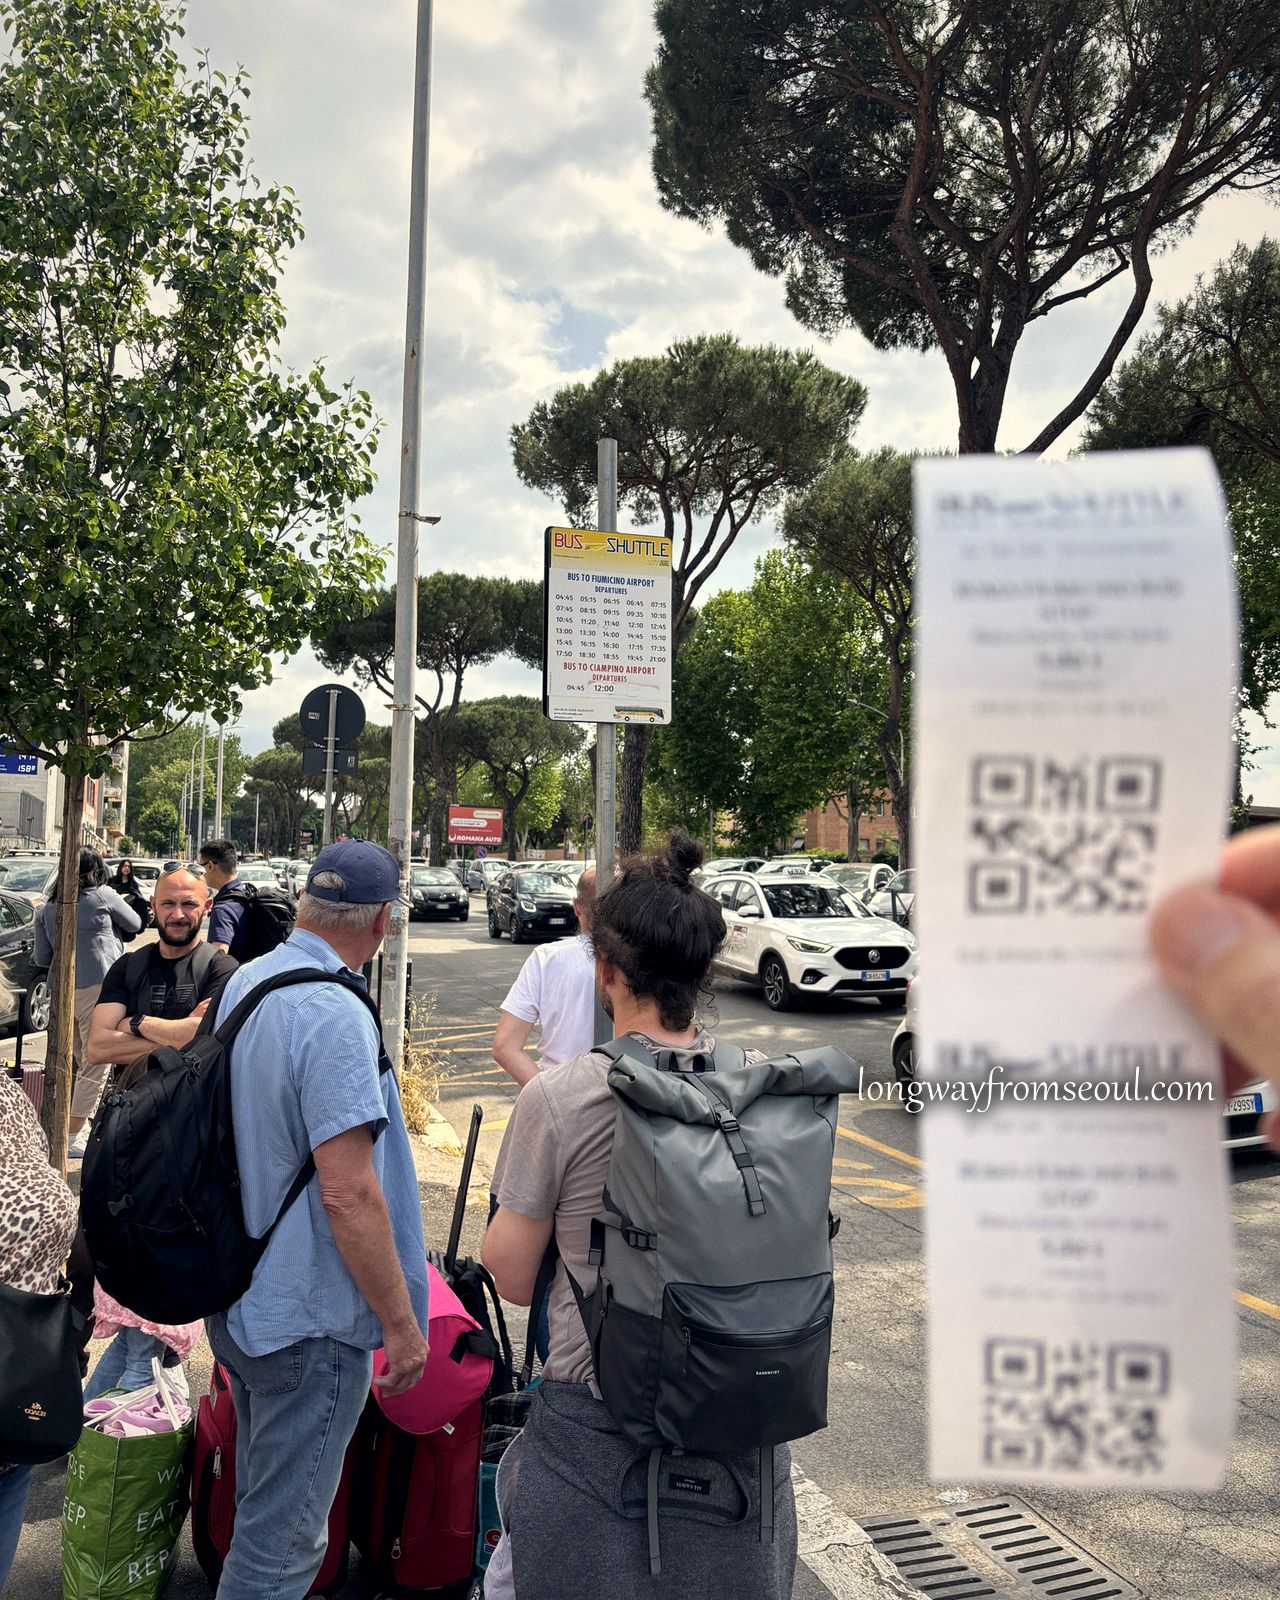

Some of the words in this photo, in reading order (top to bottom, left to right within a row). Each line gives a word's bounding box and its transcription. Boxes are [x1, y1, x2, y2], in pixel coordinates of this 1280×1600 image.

[555, 533, 582, 549] BUS
[607, 538, 669, 557] SHUTTLE
[568, 573, 579, 581] BUS
[592, 575, 625, 585] FIUMICINO
[627, 578, 654, 587] AIRPORT
[595, 586, 627, 594] DEPARTURES
[564, 662, 576, 670] BUS
[579, 663, 587, 671] TO
[590, 664, 624, 673] CIAMPINO
[626, 666, 655, 674] AIRPORT
[593, 674, 627, 682] DEPARTURES
